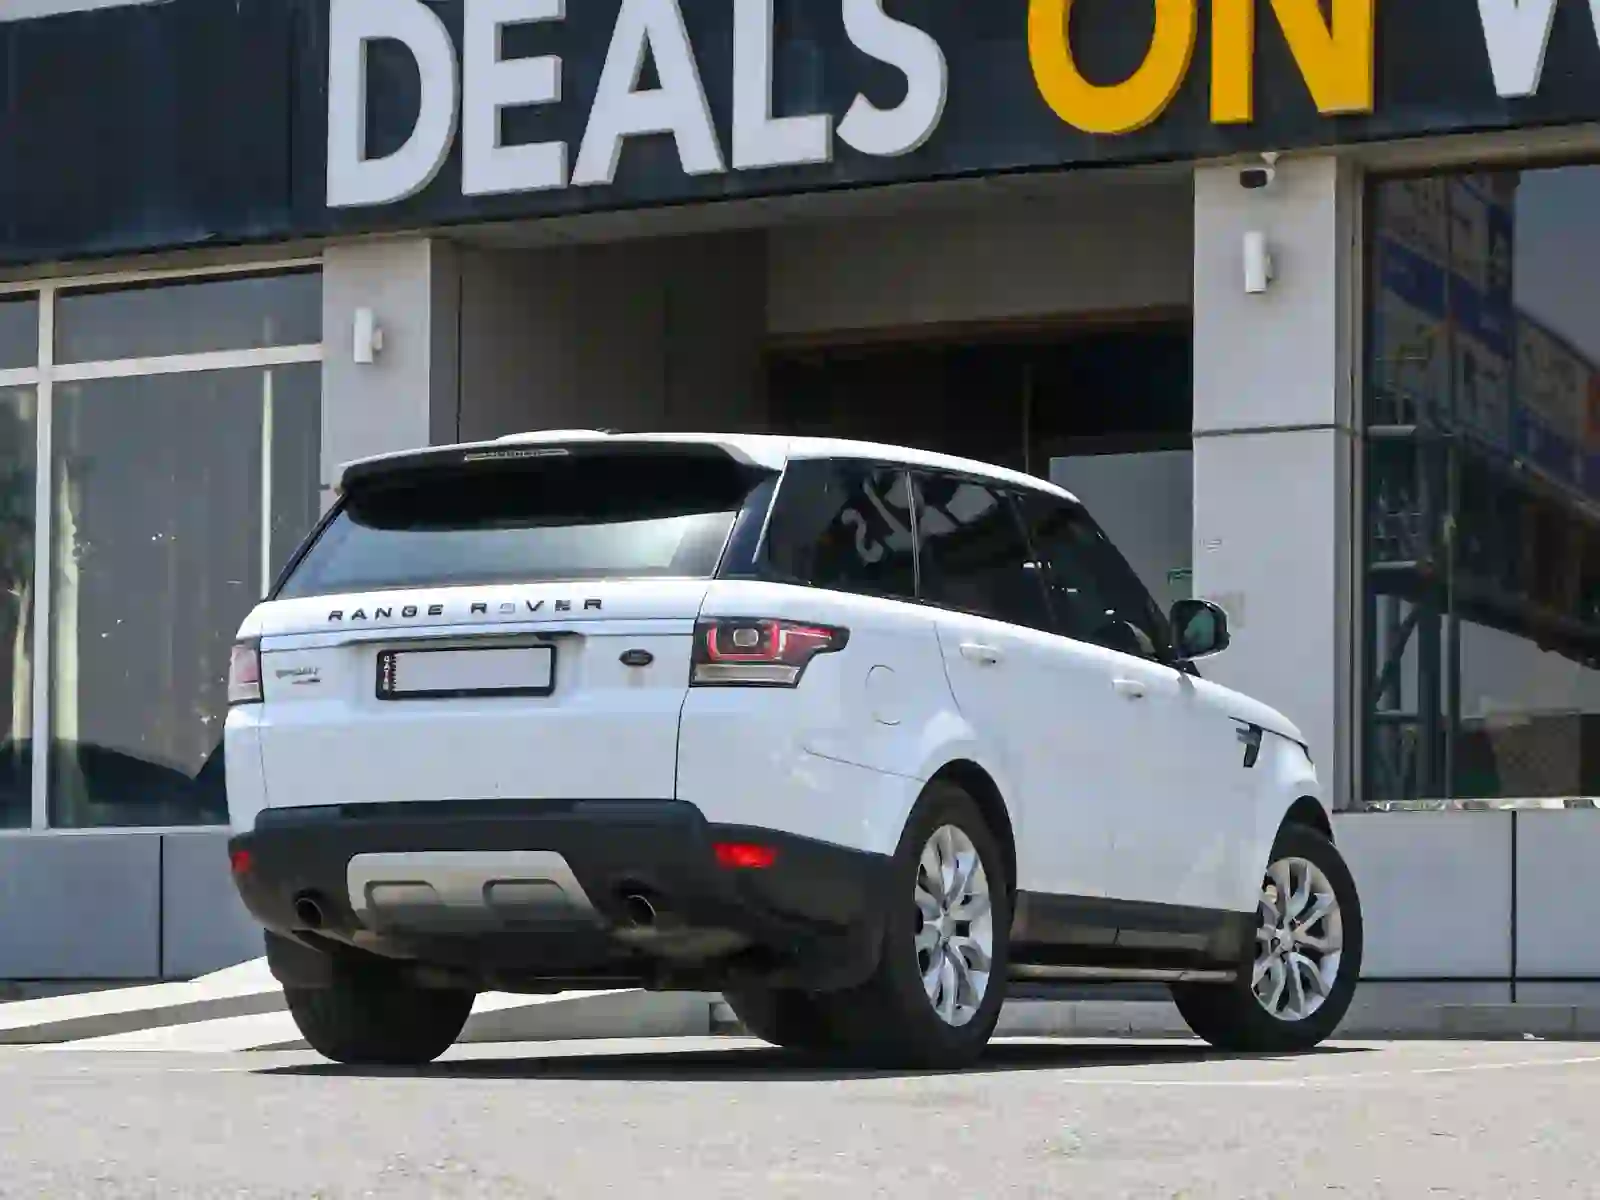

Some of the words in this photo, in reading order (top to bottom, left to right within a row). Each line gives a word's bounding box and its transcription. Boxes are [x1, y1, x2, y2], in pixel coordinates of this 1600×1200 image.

[327, 0, 948, 207] DEALS
[1028, 0, 1375, 134] ON
[328, 604, 444, 621] RANGE
[470, 598, 602, 614] ROVER
